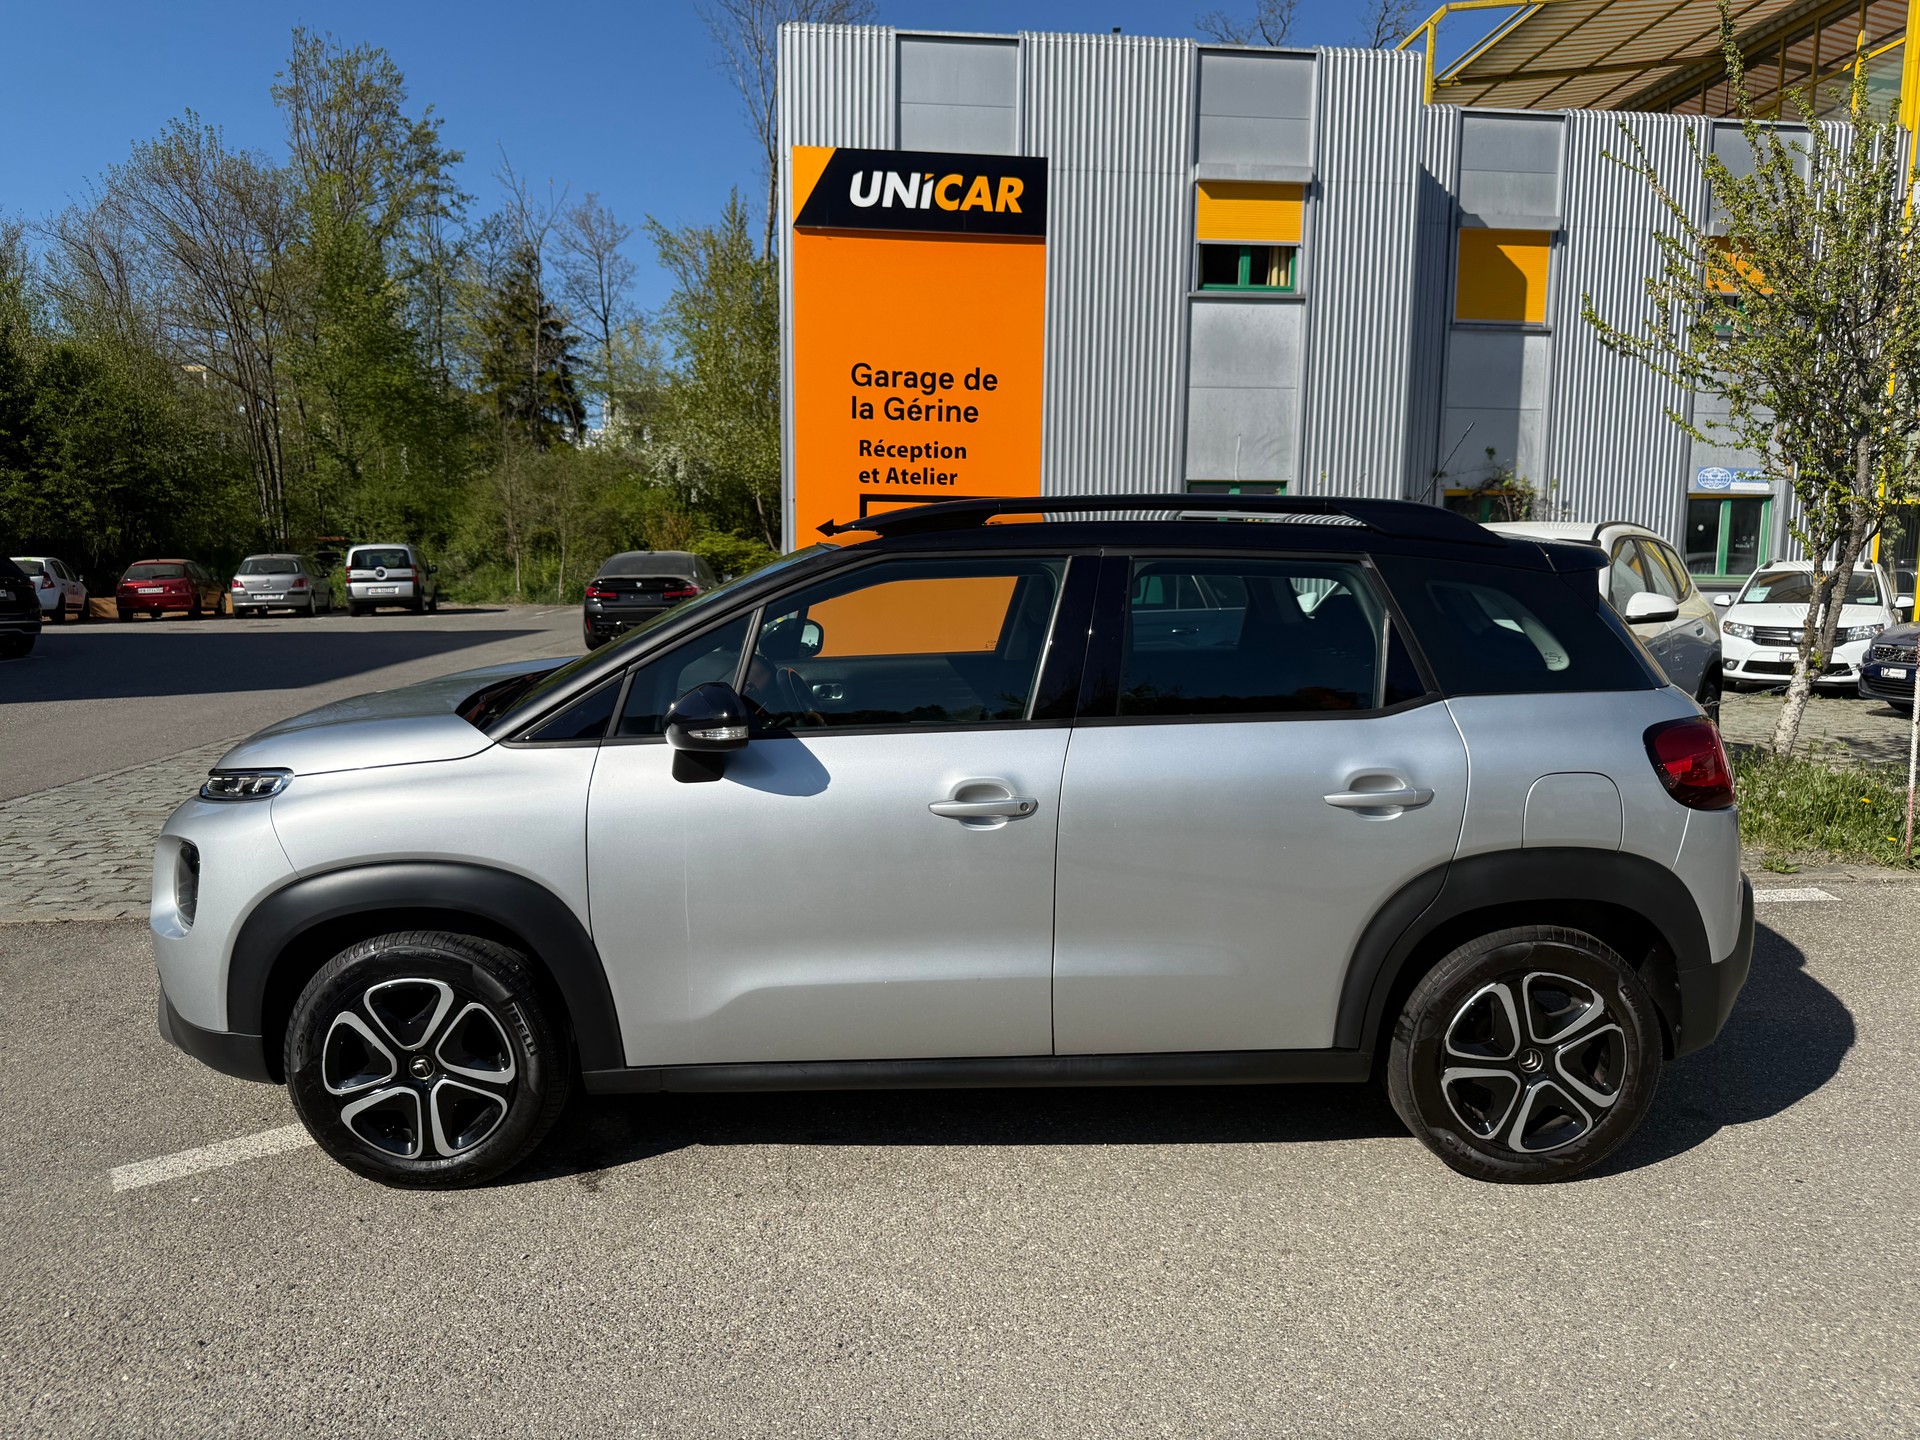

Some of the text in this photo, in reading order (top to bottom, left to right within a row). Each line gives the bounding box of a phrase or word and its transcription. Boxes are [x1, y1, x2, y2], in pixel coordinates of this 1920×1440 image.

[851, 362, 998, 396] Garage de
[851, 396, 979, 423] la Gérine
[859, 439, 967, 463] Réception
[858, 467, 958, 486] et Atelier
